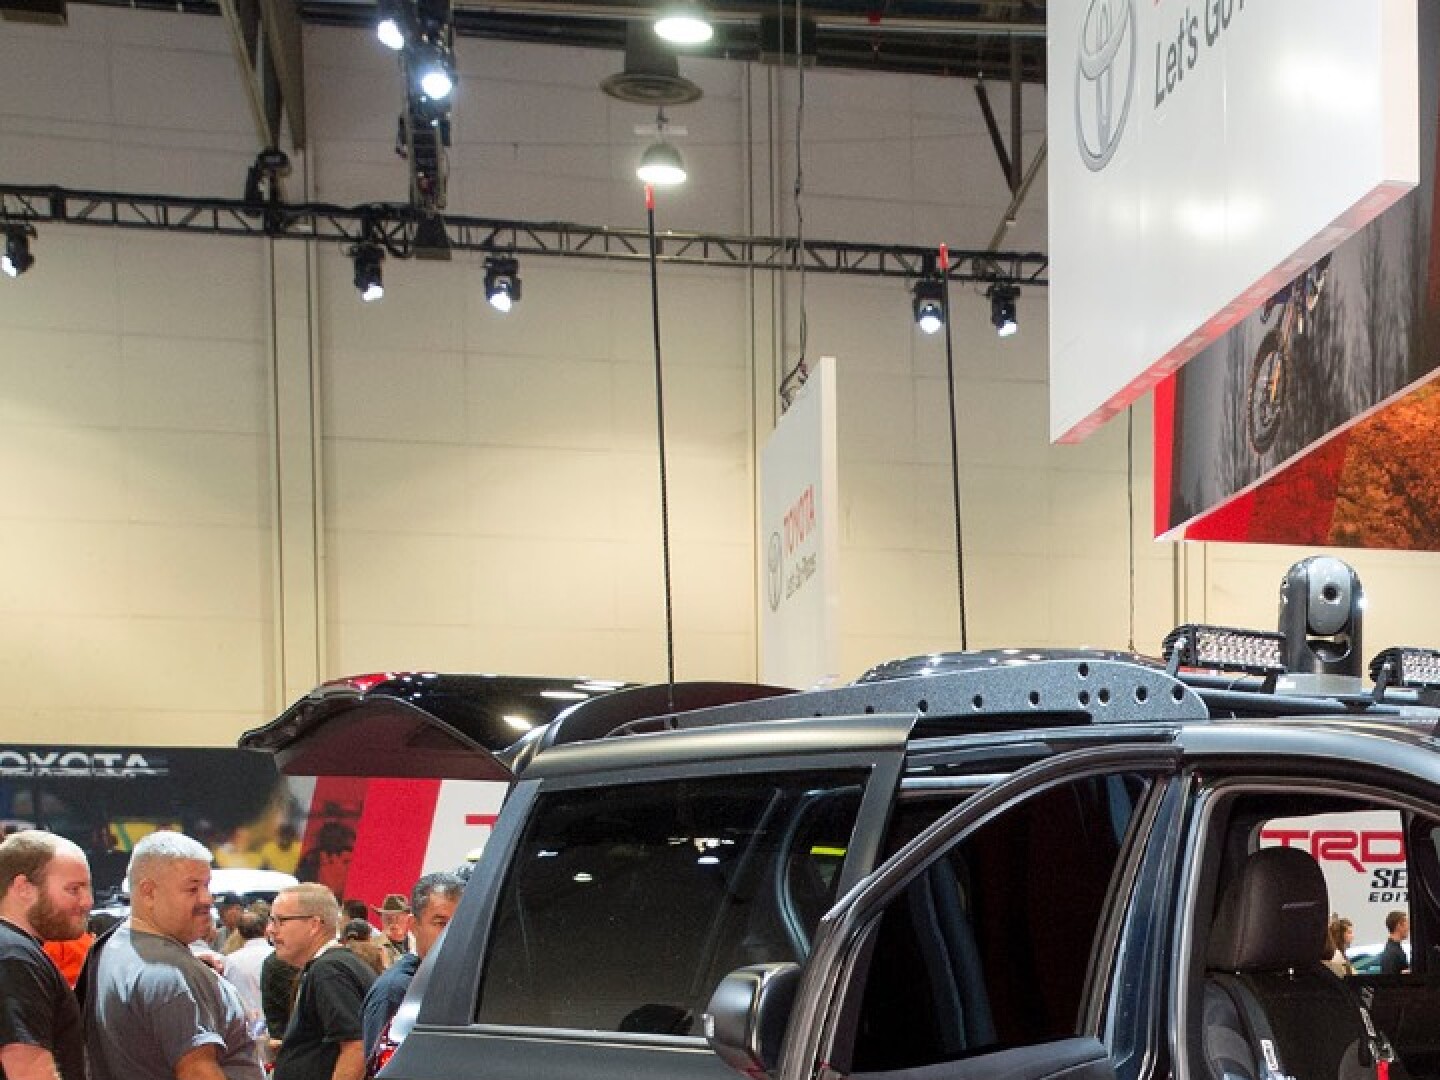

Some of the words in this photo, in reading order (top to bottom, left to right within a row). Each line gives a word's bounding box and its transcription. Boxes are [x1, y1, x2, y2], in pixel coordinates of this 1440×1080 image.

[1155, 7, 1199, 108] Let's
[1262, 830, 1406, 873] TRD
[1371, 868, 1408, 888] SE
